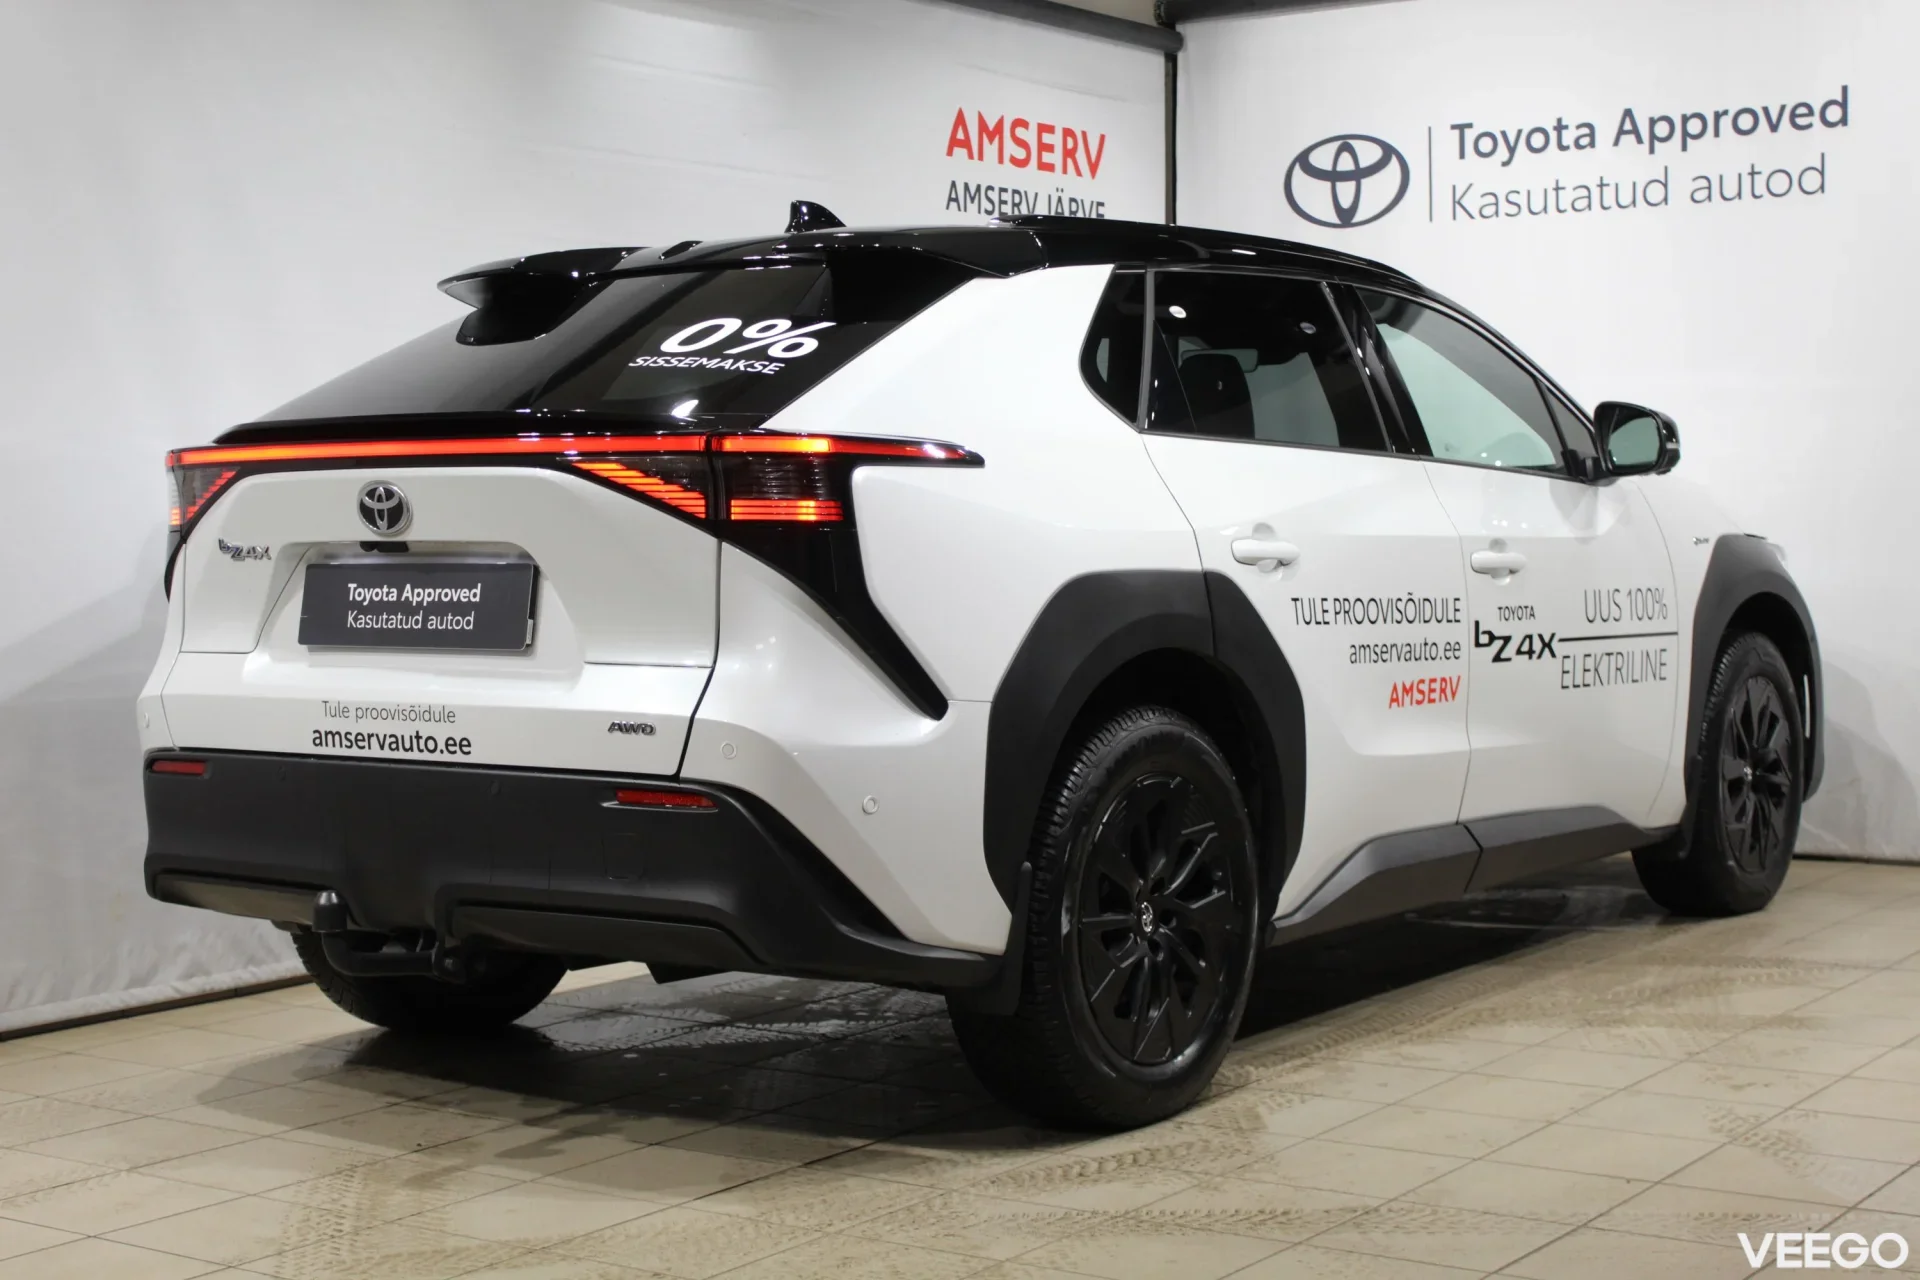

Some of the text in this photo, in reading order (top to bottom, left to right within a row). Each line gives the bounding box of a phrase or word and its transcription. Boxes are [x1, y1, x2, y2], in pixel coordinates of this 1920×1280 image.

[1450, 84, 1850, 166] Toyota Approved
[946, 106, 1106, 180] AMSERV
[946, 180, 1038, 215] AMSERV
[1451, 152, 1828, 221] Kasutatud autod
[660, 317, 837, 358] 0%
[628, 355, 785, 375] SISSEMAKSE
[347, 583, 481, 604] Toyota Approved
[1291, 591, 1461, 626] TULE PROOVISÕIDULE
[1584, 587, 1668, 624] UUS 100%
[346, 609, 475, 630] Kasutatud autod
[1497, 606, 1536, 621] TOYOTA
[1349, 637, 1461, 665] amservauto.ee
[1560, 648, 1668, 690] ELEKTRILINE
[1388, 674, 1461, 708] AMSERV
[321, 700, 456, 725] Tule proovisõidule
[607, 720, 656, 735] AWD
[312, 726, 472, 756] amservauto.ee
